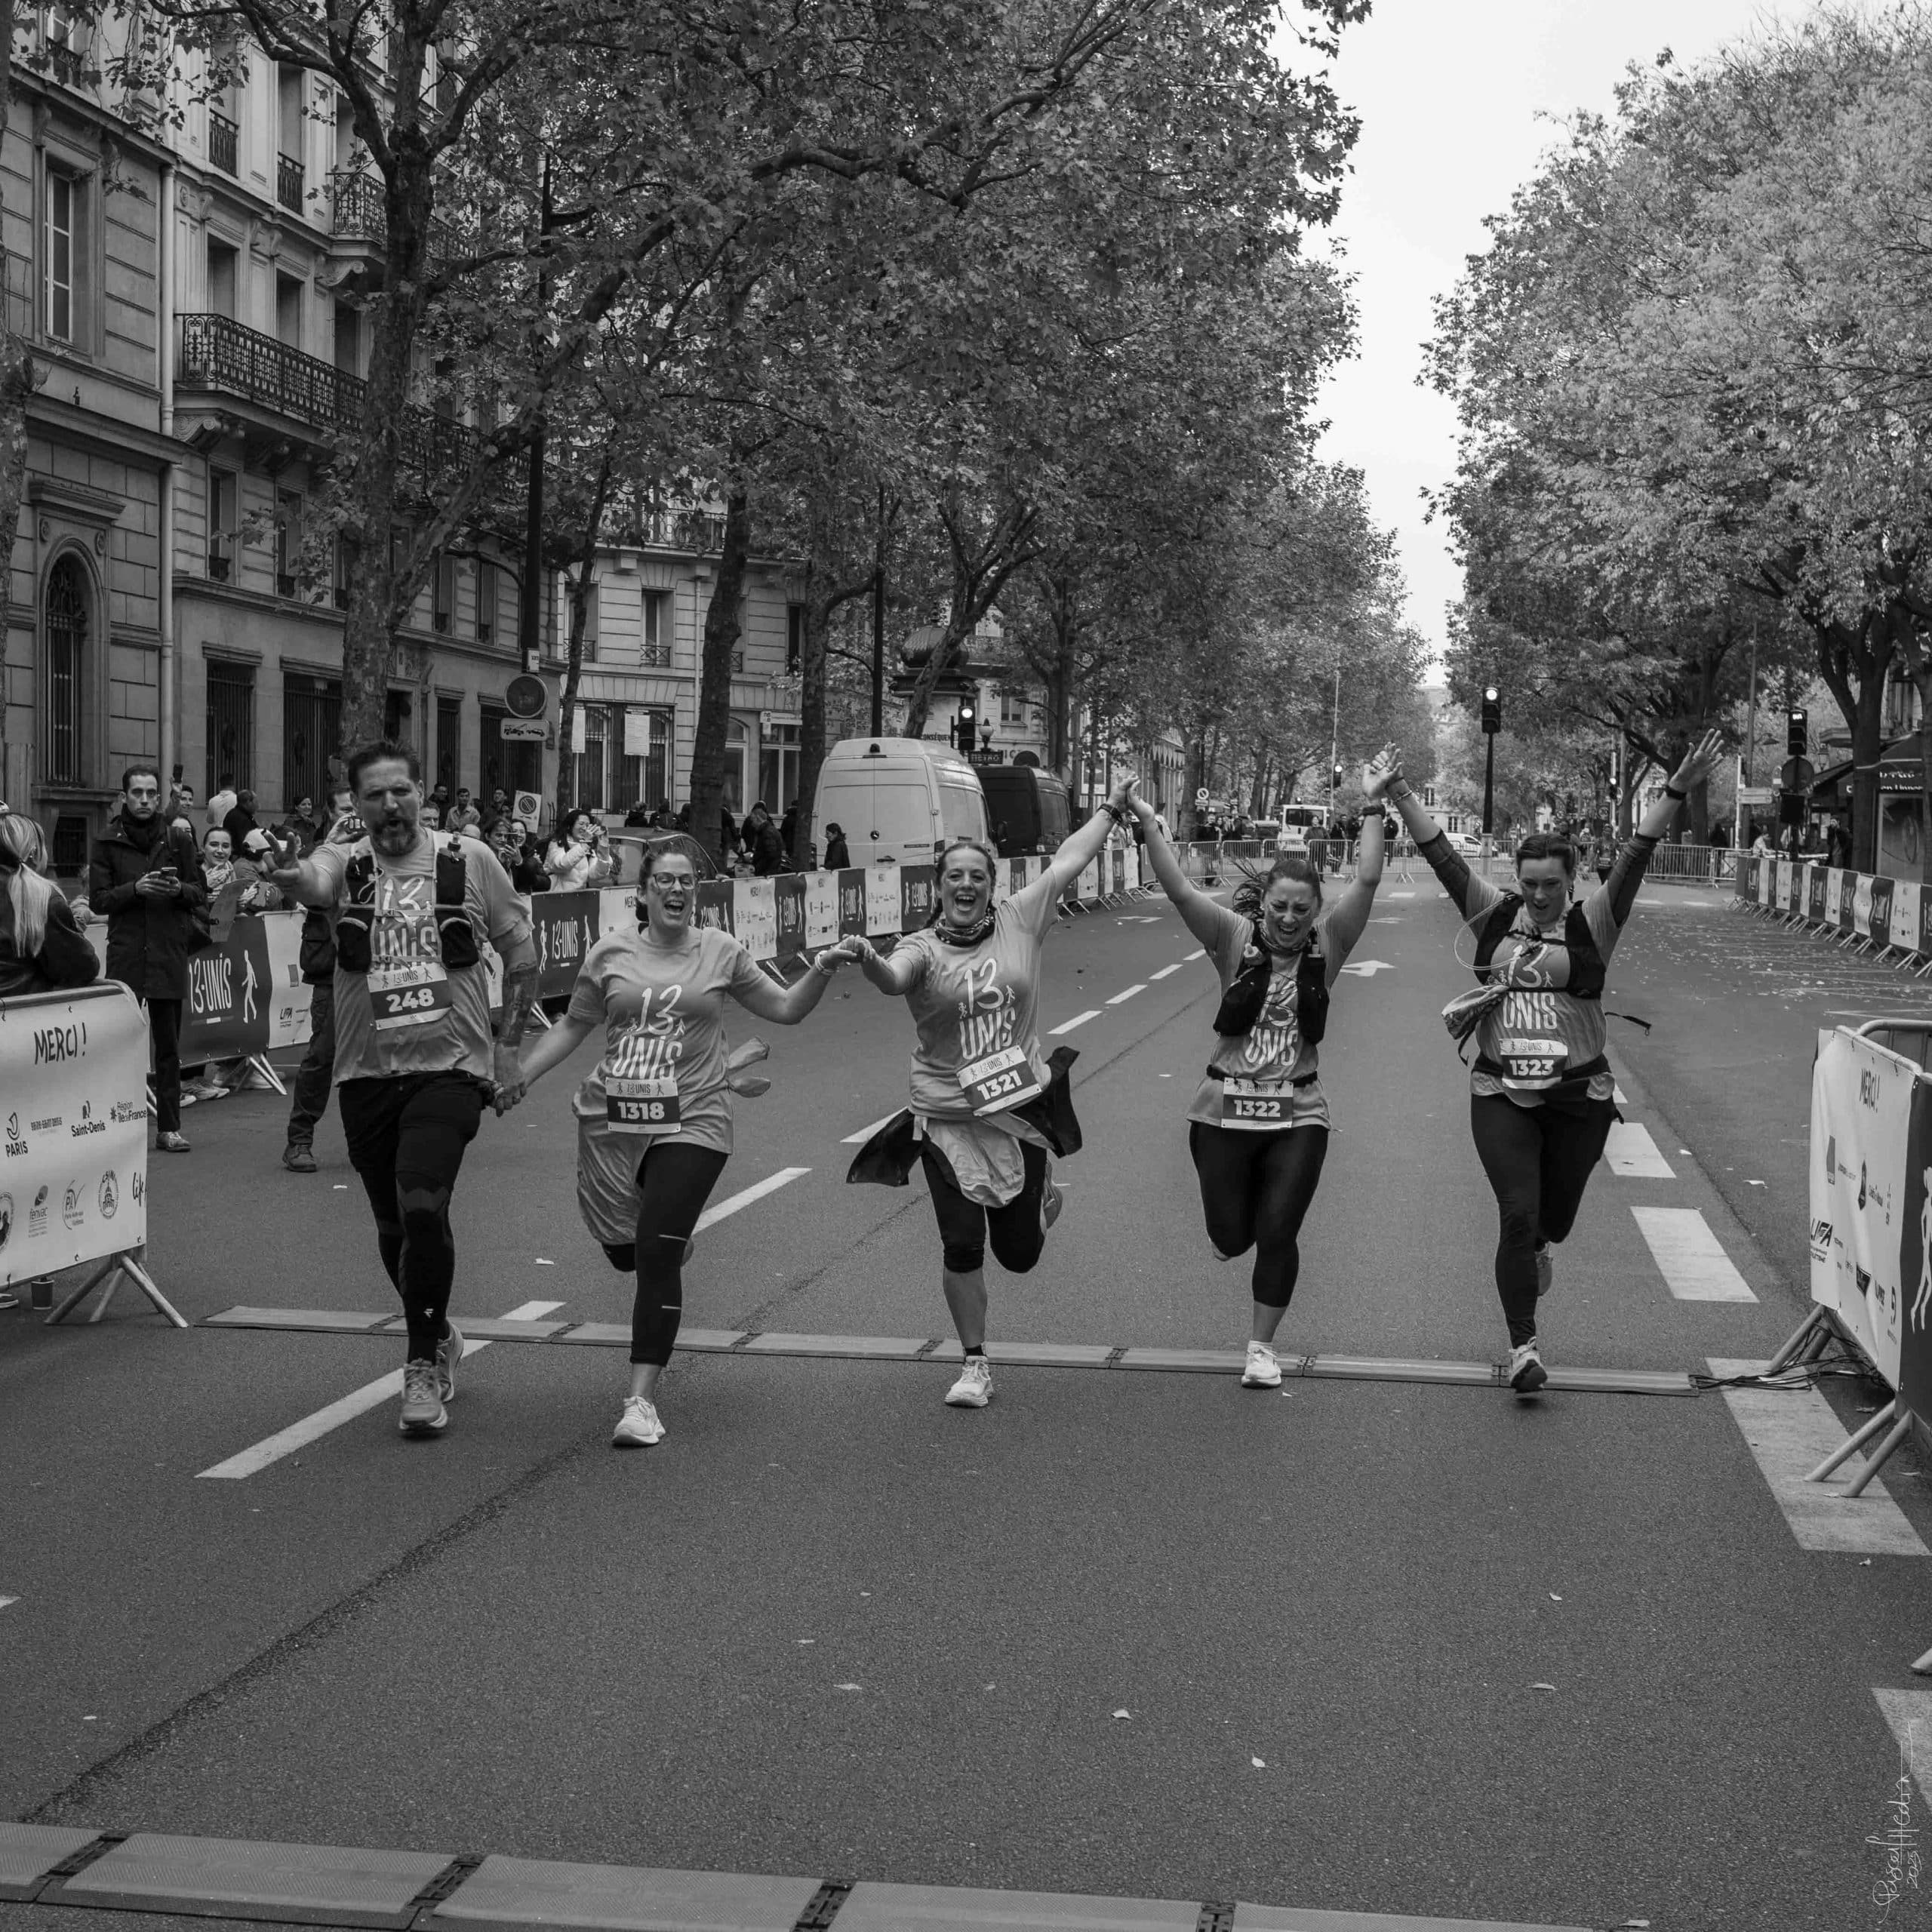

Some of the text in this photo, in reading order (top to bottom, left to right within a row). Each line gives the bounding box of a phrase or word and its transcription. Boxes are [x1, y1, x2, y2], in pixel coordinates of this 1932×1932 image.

[1508, 944, 1548, 988] 13
[386, 988, 435, 1013] 248
[964, 958, 1004, 1015] 13
[636, 984, 682, 1035] 13
[1503, 992, 1558, 1029] UNIS
[959, 1006, 1016, 1060] UNIS
[1245, 1026, 1299, 1066] UNIS
[612, 1035, 683, 1079] UNIS
[1509, 1059, 1555, 1076] 1323
[977, 1069, 1023, 1101] 1321
[617, 1101, 665, 1120] 1318
[1234, 1099, 1281, 1118] 1322
[71, 1120, 106, 1137] Saint-Denis
[5, 1140, 29, 1158] PARIS
